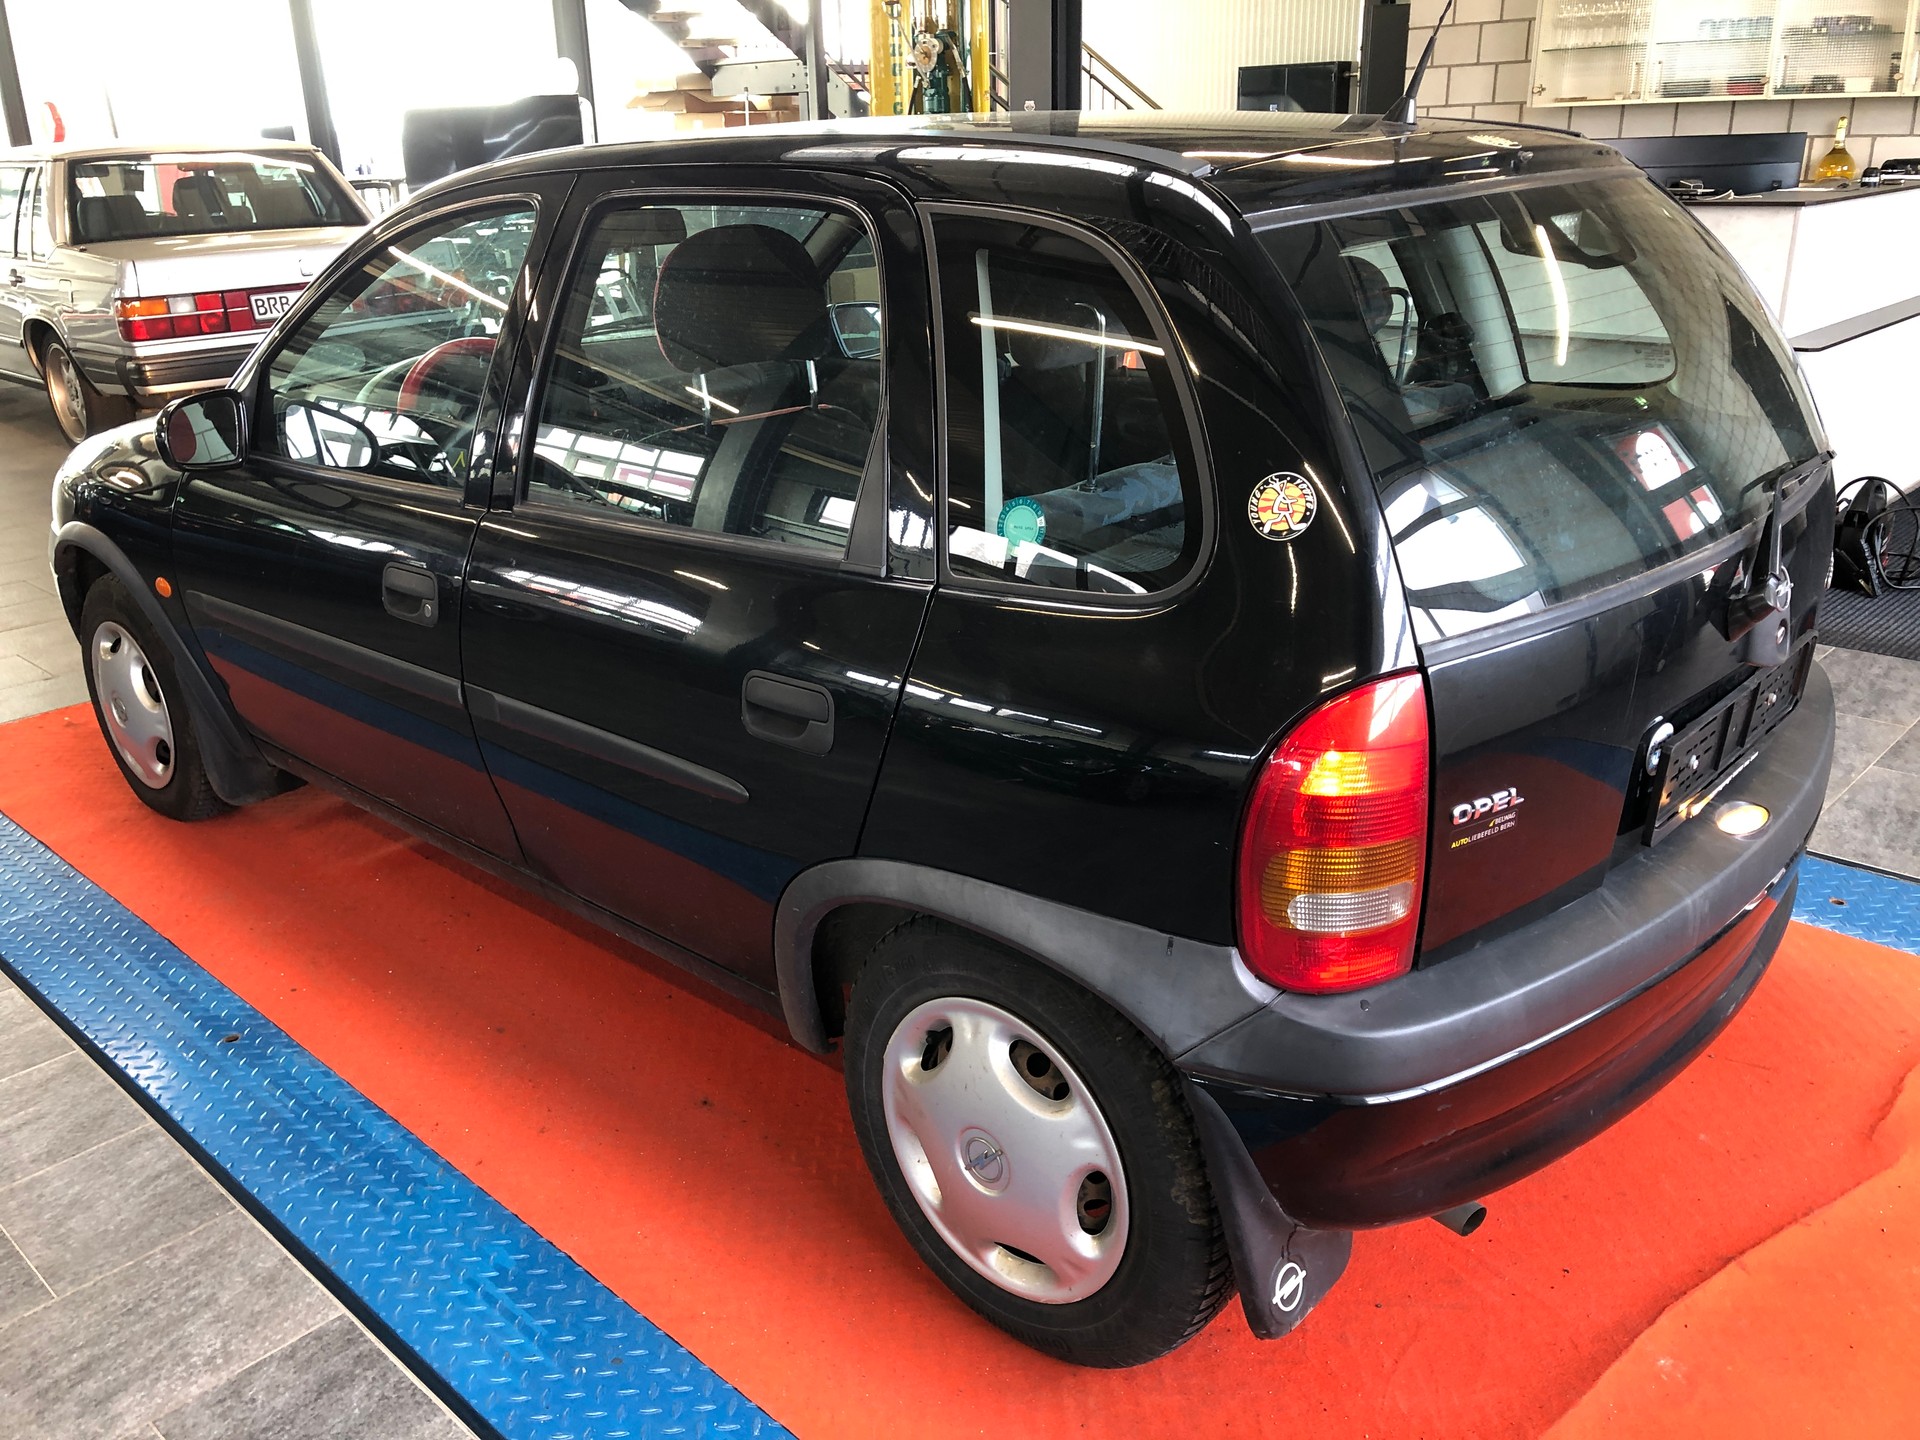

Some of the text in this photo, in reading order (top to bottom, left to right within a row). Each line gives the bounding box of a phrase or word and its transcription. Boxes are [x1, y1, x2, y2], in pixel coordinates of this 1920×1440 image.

[1250, 489, 1262, 525] YOUNG
[1293, 478, 1314, 510] YOUNG
[1452, 787, 1525, 826] OPEL
[1500, 821, 1515, 831] BERN
